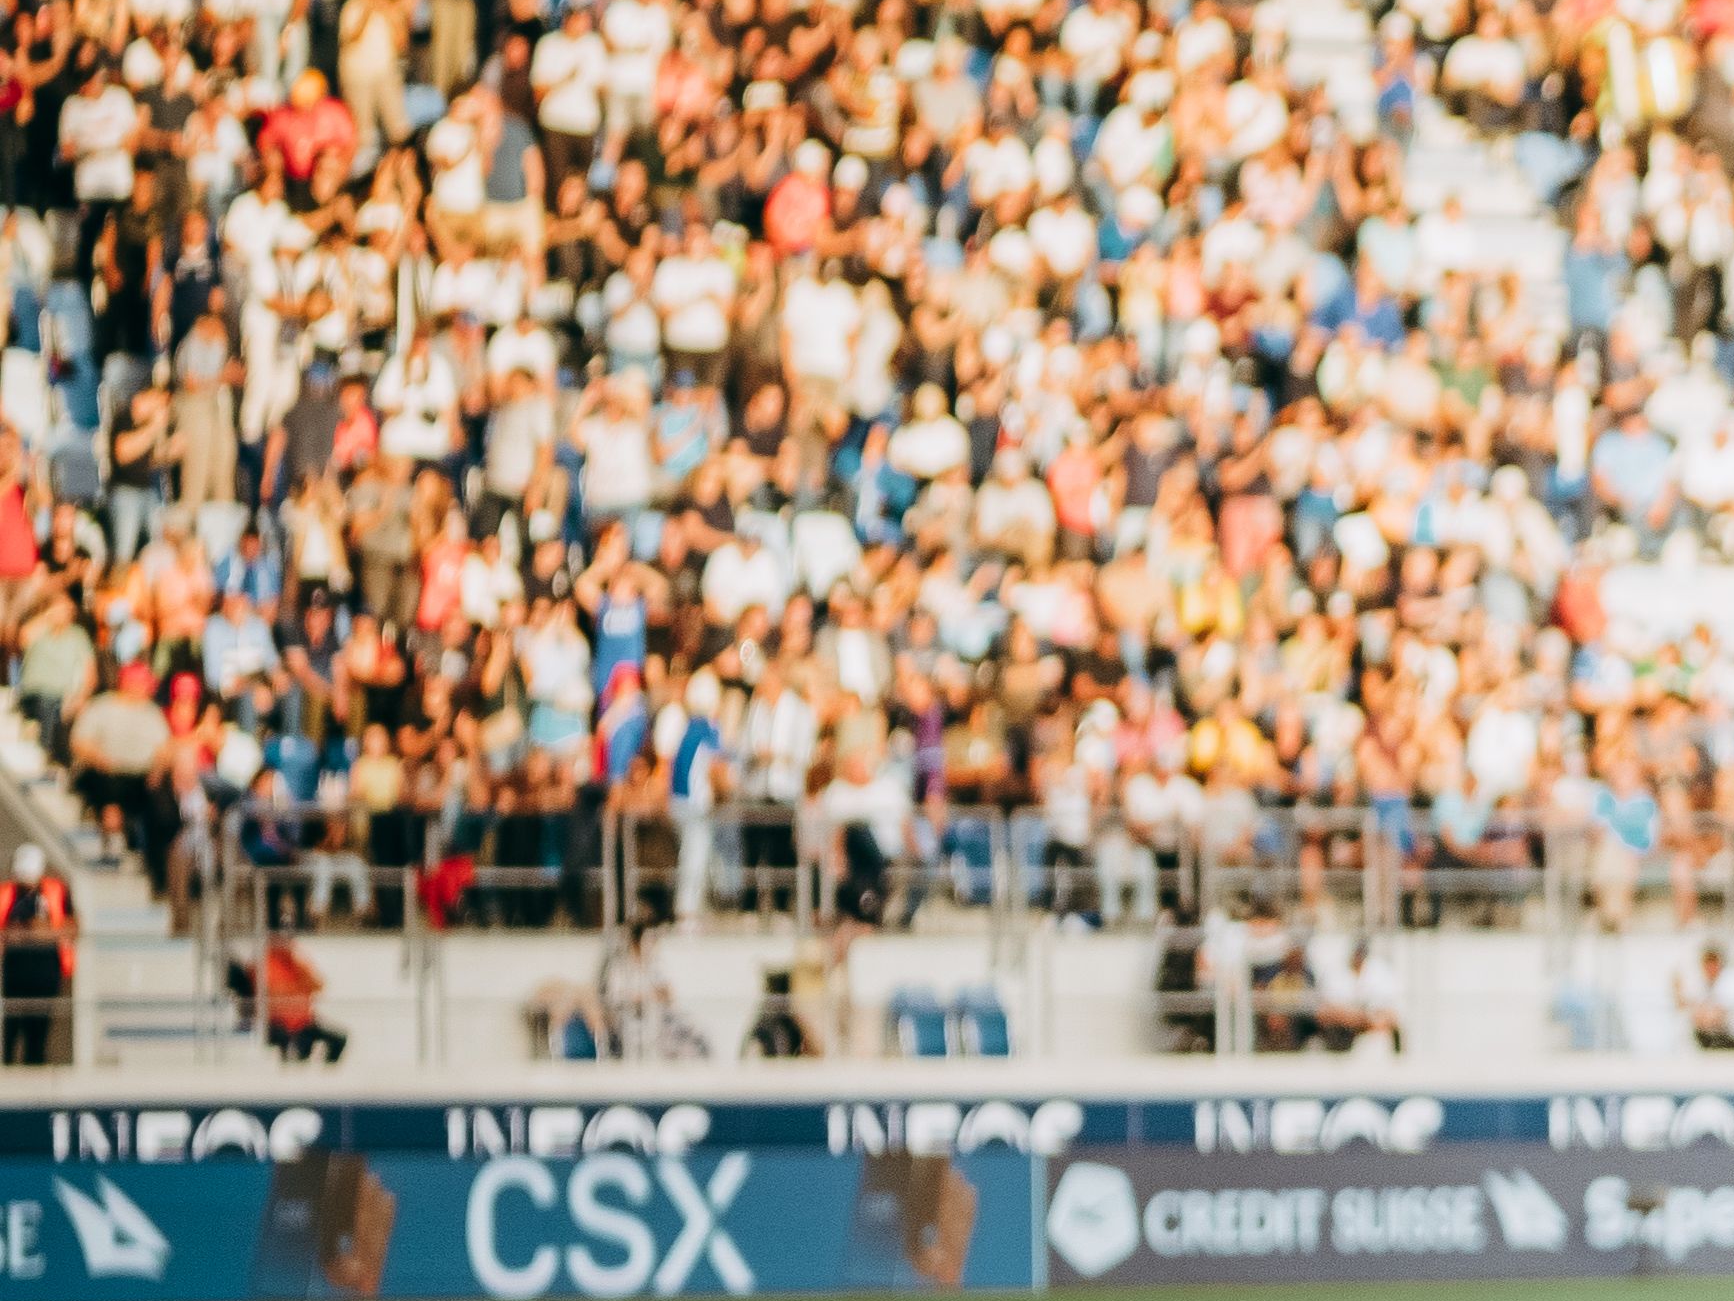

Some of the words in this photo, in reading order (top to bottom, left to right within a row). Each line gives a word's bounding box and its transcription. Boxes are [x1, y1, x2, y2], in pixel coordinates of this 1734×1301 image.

[465, 1152, 756, 1301] CSX
[1145, 1187, 1328, 1259] CREDIT
[1329, 1185, 1489, 1255] SUISSE
